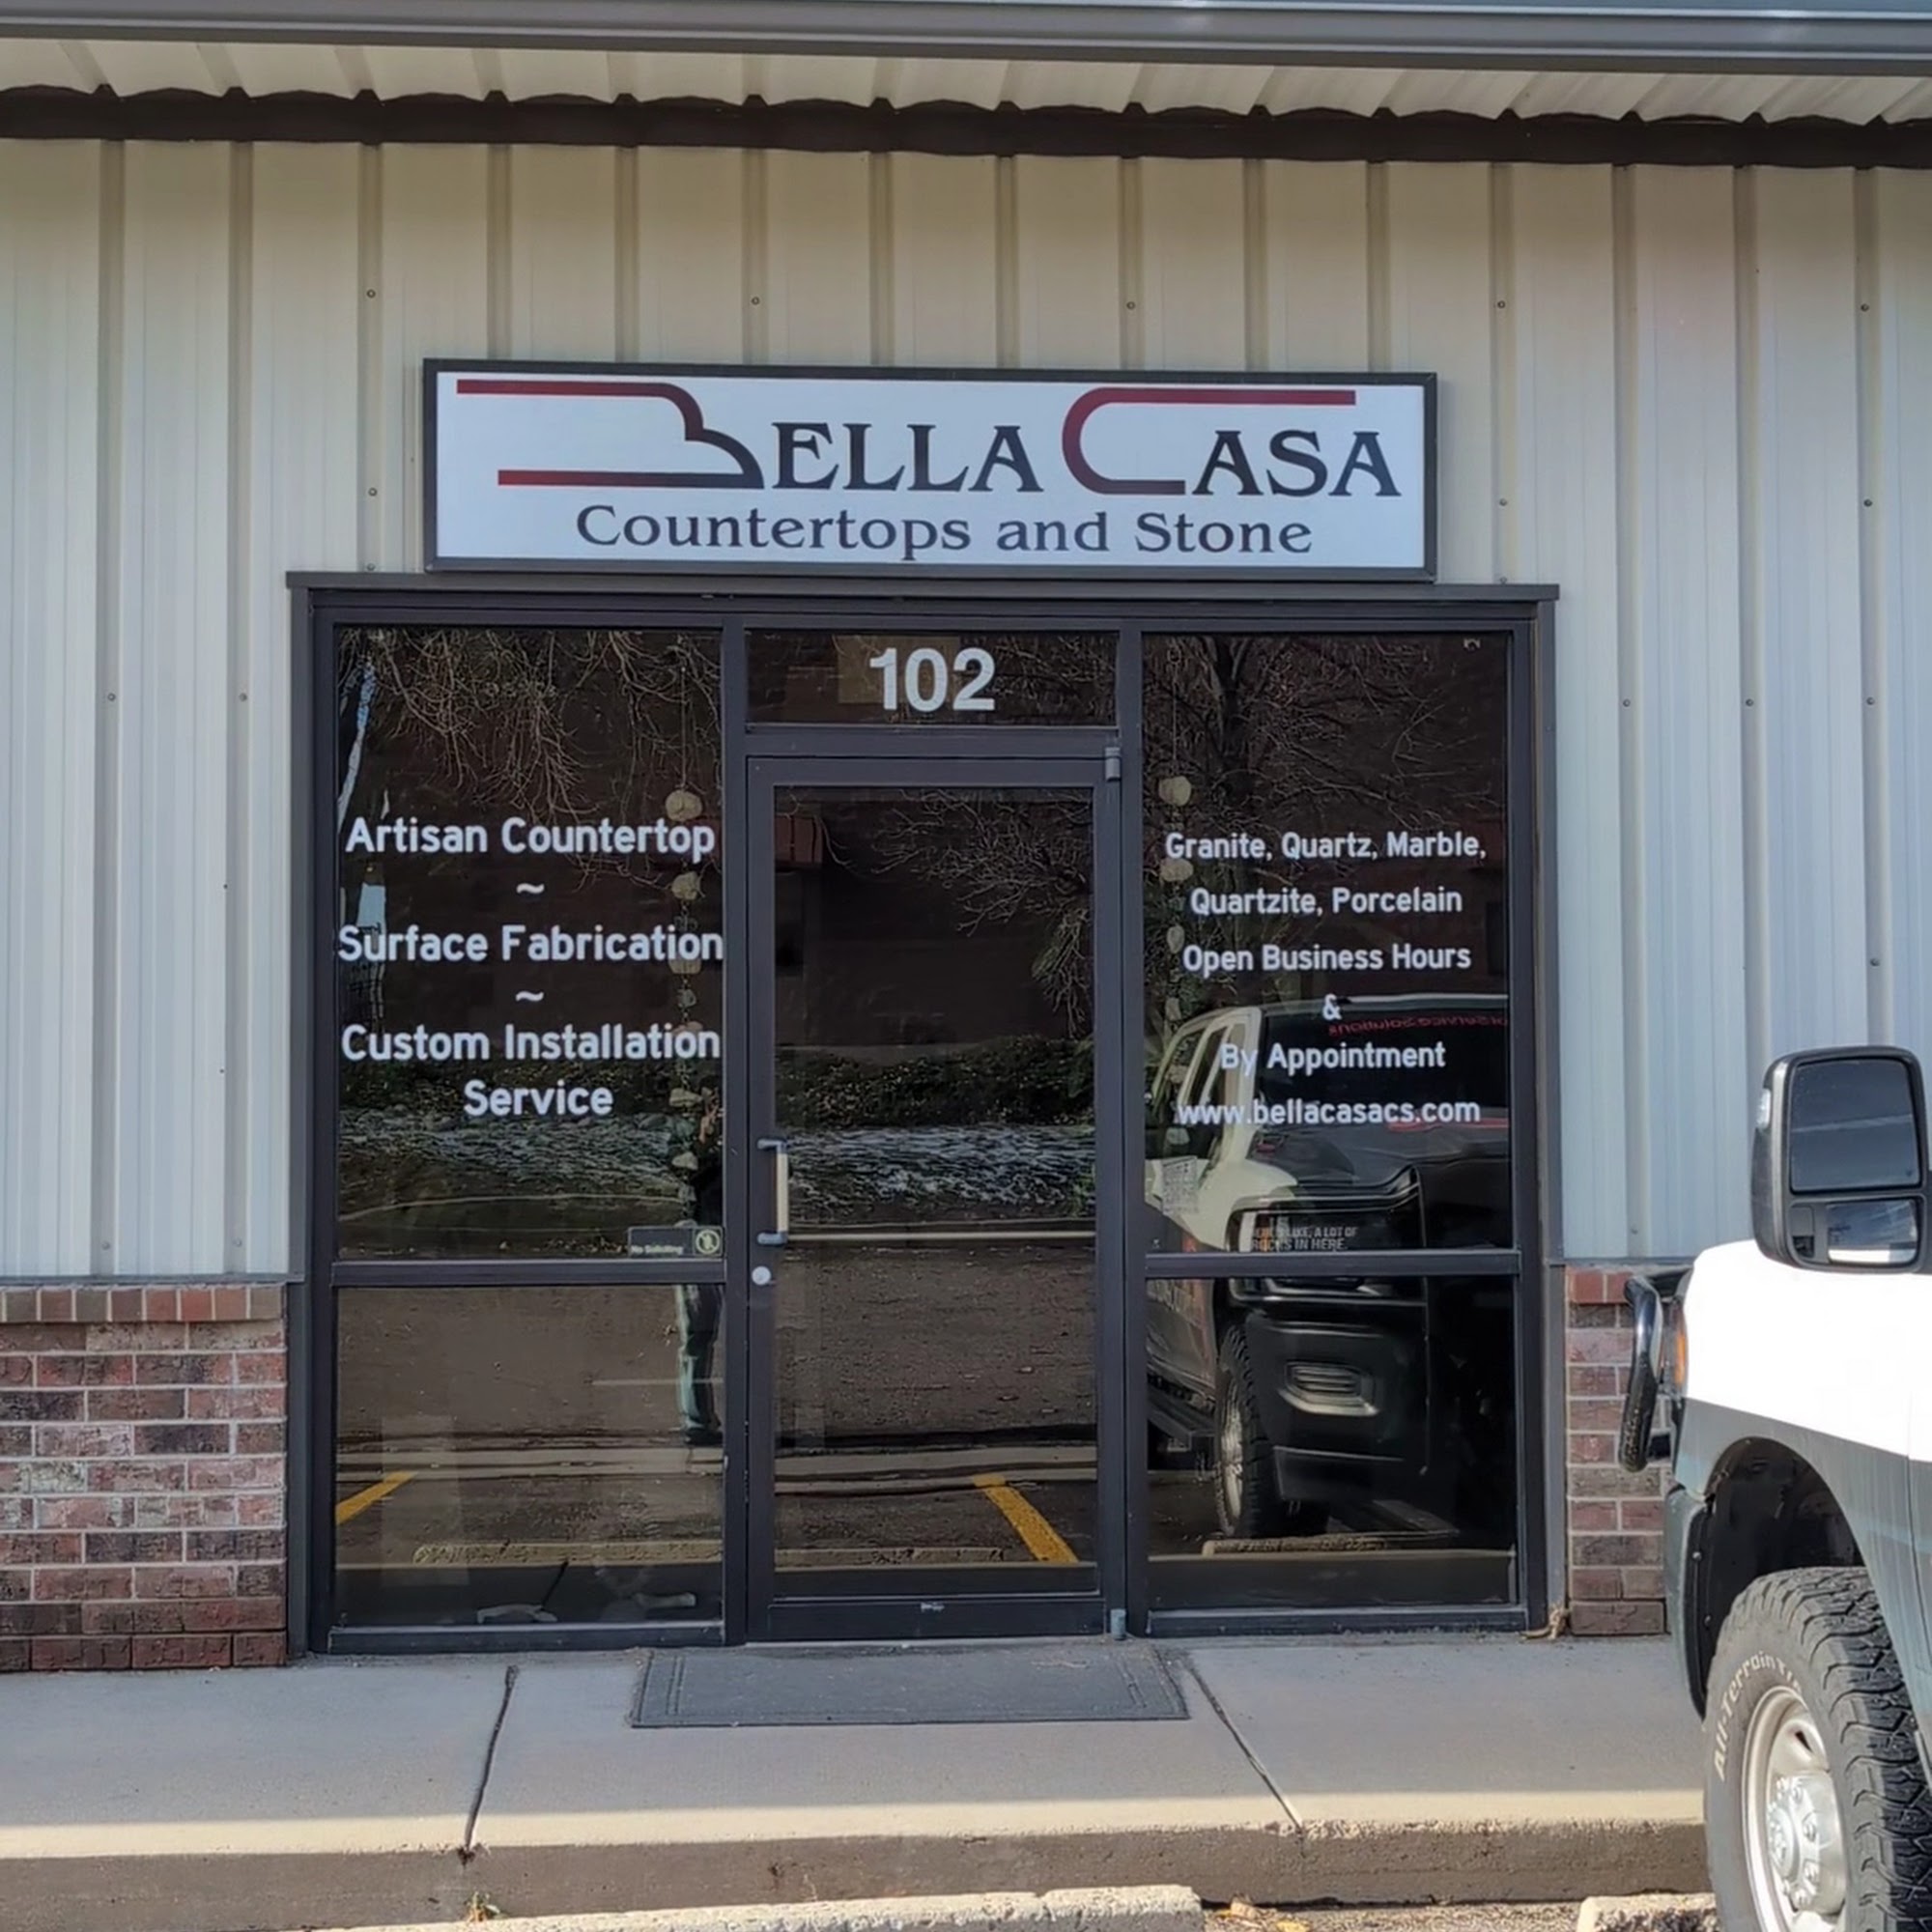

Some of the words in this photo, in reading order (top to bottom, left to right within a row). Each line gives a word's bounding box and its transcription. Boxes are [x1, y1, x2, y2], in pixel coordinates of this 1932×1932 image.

[457, 379, 1044, 492] BELLA
[1061, 386, 1402, 497] CASA
[576, 505, 971, 561] Countertops
[996, 512, 1110, 552] and
[1134, 512, 1313, 554] Stone
[869, 647, 996, 712] 102
[345, 816, 488, 854] Artisan
[500, 816, 716, 864] Countertop
[1165, 832, 1273, 861] Granite,
[1281, 831, 1379, 861] Quartz,
[1386, 831, 1487, 860] Marble,
[1189, 887, 1323, 916] Quartzite,
[1332, 886, 1463, 914] Porcelain
[337, 924, 489, 962] Surface
[500, 924, 724, 961] Fabrication
[1182, 944, 1254, 979] Open
[1262, 944, 1383, 971] Business
[1392, 943, 1472, 970] Hours
[1321, 993, 1343, 1021] &
[341, 1024, 490, 1061] Custom
[504, 1022, 721, 1060] Installation
[1221, 1043, 1258, 1077] By
[1266, 1041, 1446, 1077] Appointment
[463, 1078, 614, 1116] Service
[1176, 1098, 1481, 1125] www.bellacasacs.com
